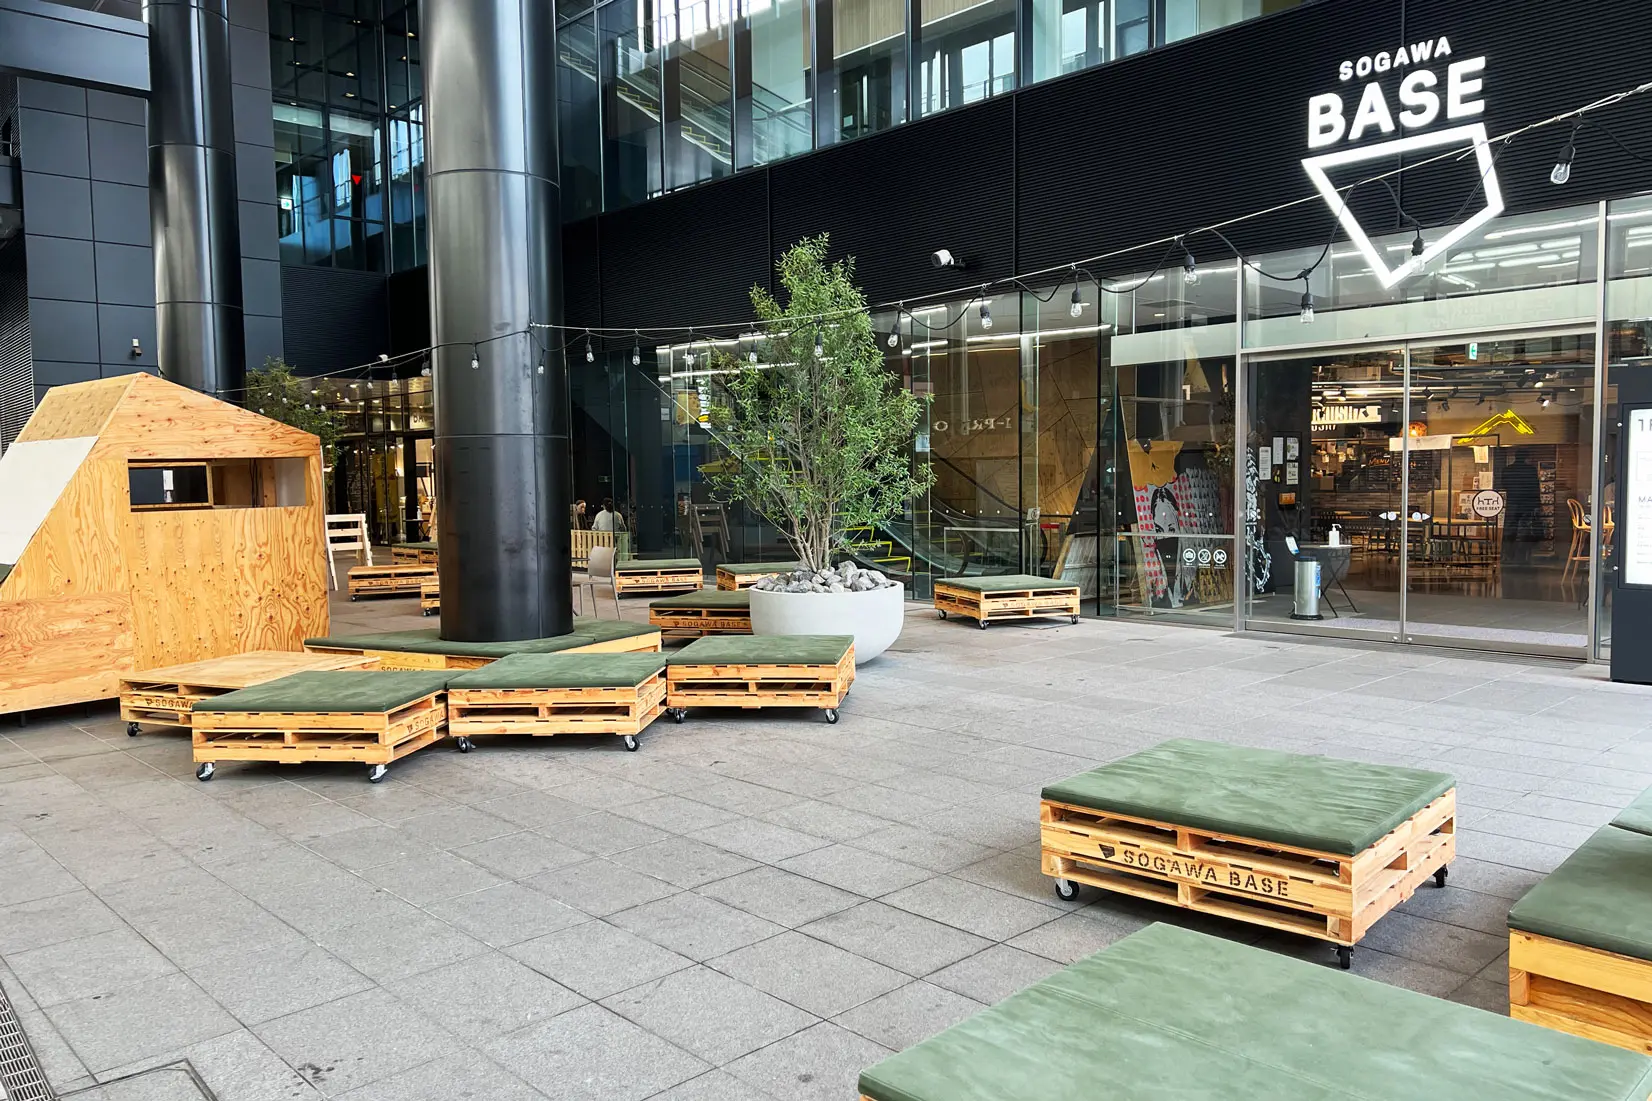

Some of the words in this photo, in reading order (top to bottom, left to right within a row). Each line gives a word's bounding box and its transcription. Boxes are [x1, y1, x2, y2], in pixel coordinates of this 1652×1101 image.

[1338, 36, 1452, 81] SOGAWA
[1307, 56, 1486, 149] BASE
[415, 710, 444, 730] SOGAWA
[1123, 850, 1218, 882] SOGAWA
[1230, 872, 1288, 896] BASE
